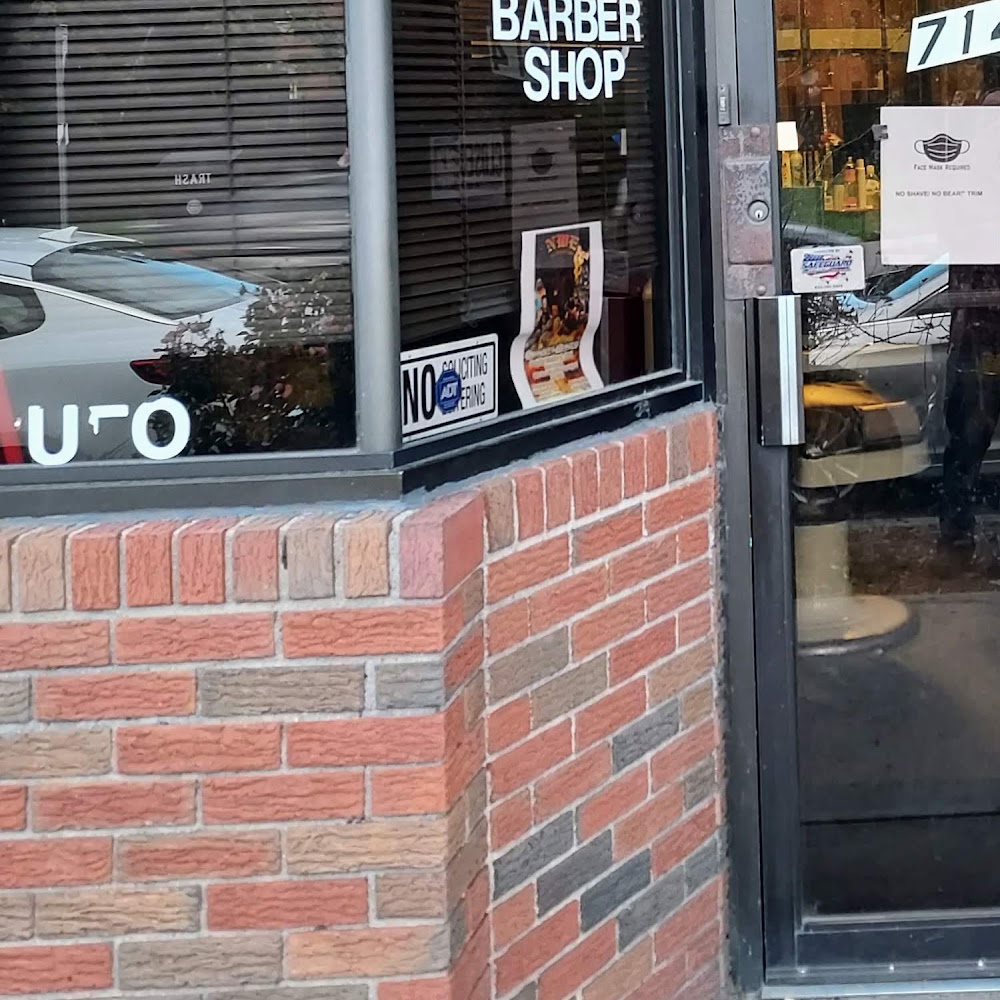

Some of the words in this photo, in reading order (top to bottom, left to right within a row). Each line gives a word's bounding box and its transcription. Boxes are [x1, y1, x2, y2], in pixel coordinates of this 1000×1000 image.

[523, 46, 626, 102] SHOP
[403, 363, 436, 426] NO
[440, 382, 459, 401] ADT
